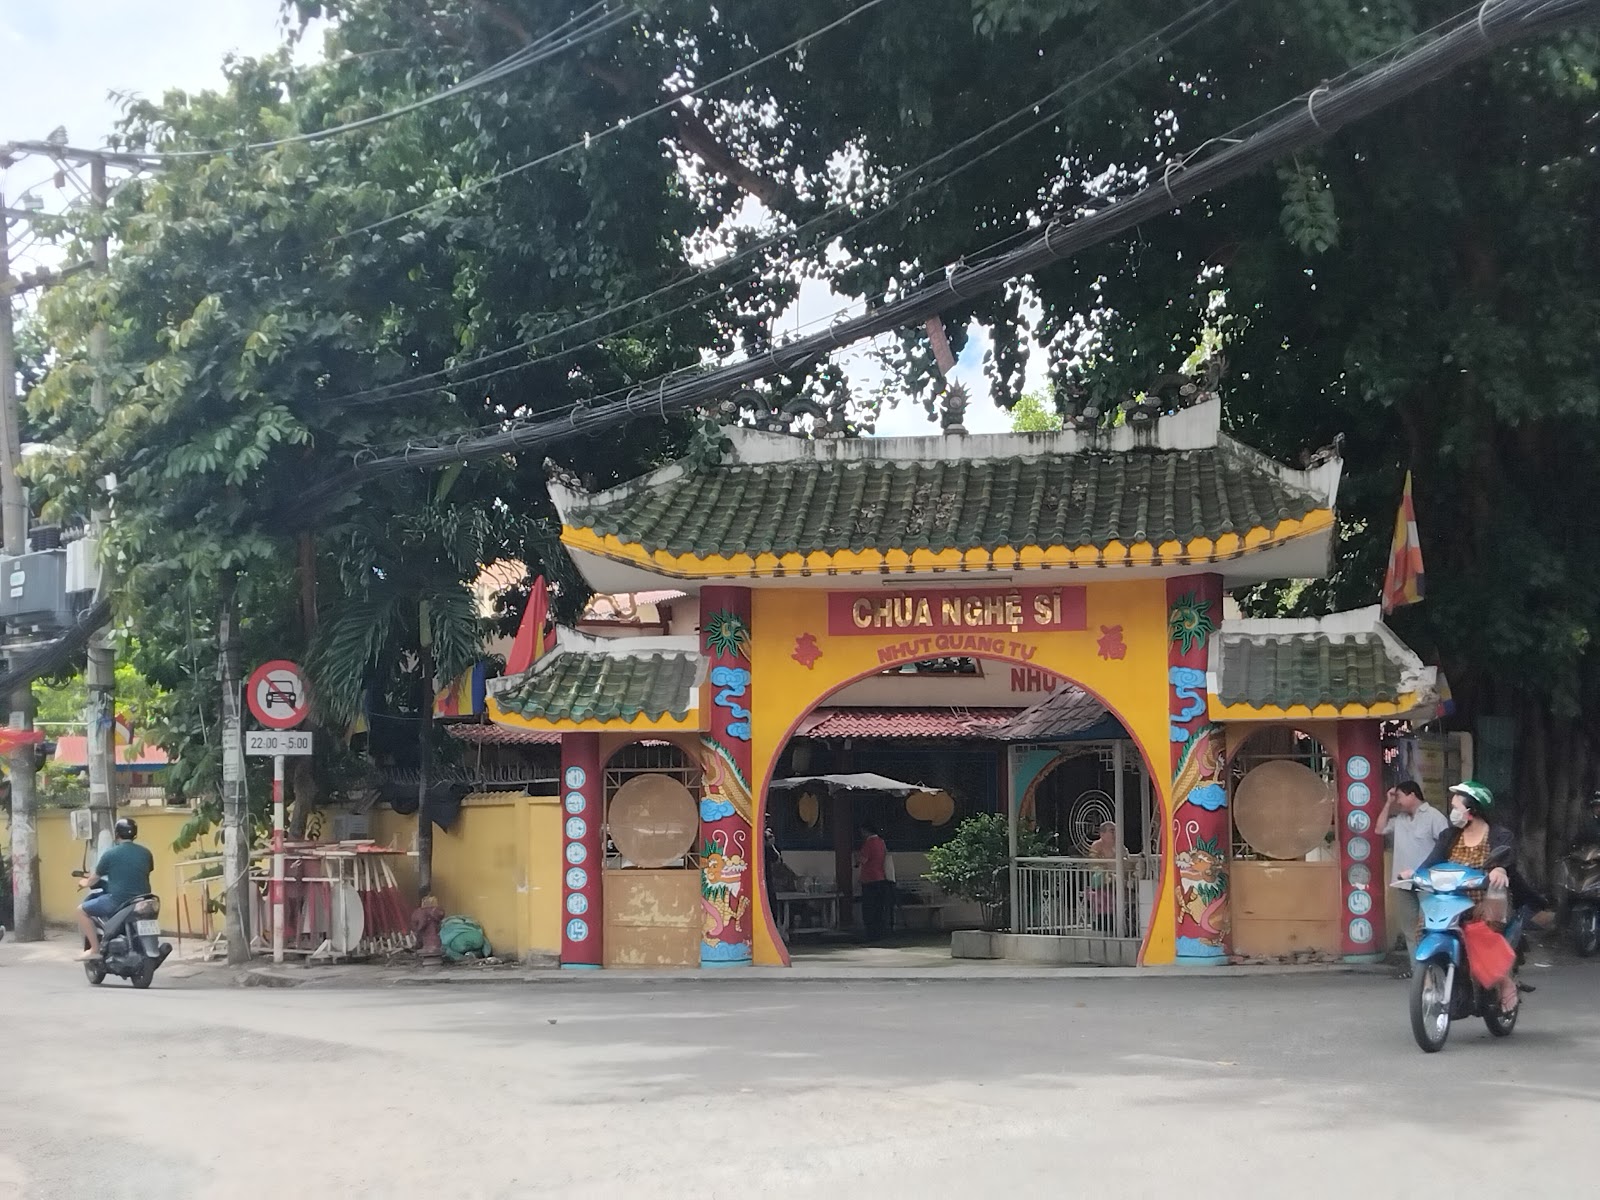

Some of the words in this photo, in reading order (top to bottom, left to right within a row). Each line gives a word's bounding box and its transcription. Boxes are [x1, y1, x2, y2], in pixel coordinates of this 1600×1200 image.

[941, 588, 1024, 633] NGHỆ
[1033, 586, 1063, 626] SĨ
[935, 634, 1006, 653] QUANG
[251, 737, 278, 749] 22:00
[288, 737, 308, 749] 5:00
